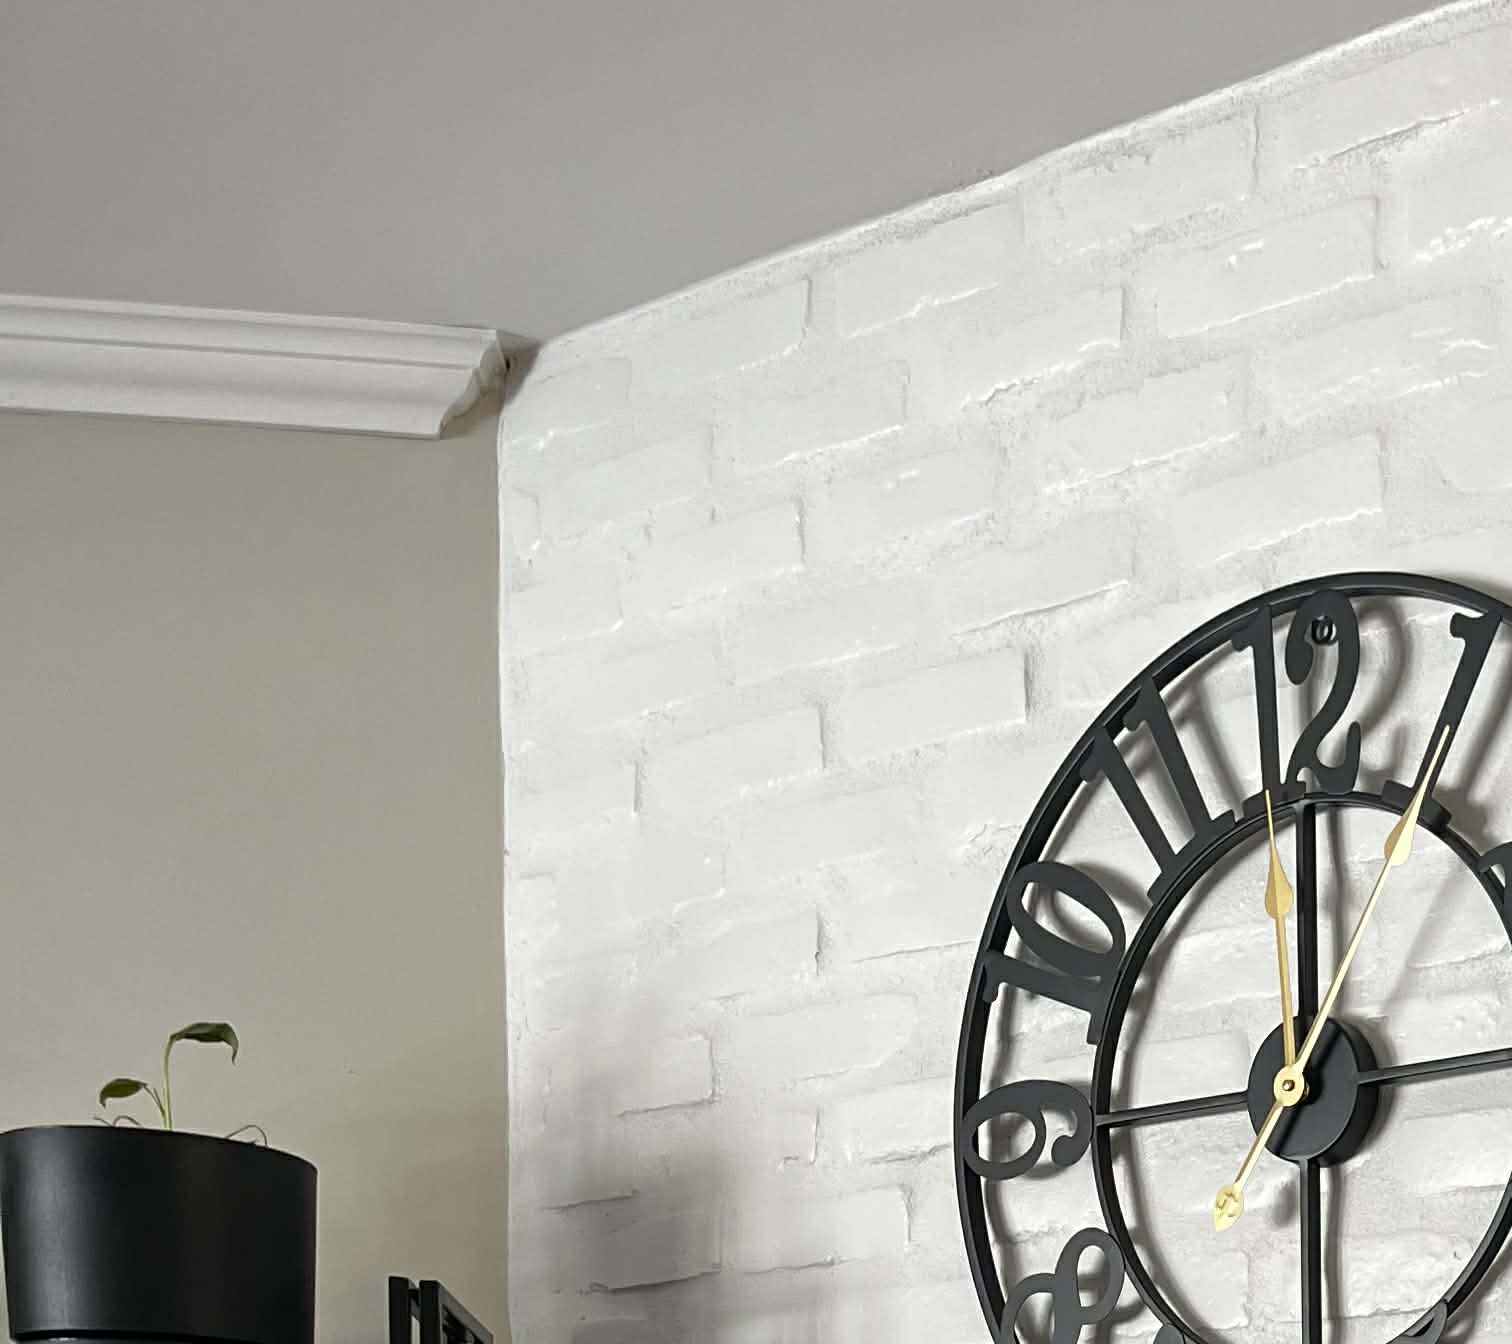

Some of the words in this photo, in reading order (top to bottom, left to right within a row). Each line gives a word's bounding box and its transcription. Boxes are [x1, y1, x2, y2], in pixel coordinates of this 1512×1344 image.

[1080, 677, 1241, 902] 11
[1231, 589, 1360, 816] 12
[1382, 609, 1502, 829] 1
[984, 862, 1126, 1045] 10
[962, 1079, 1094, 1179] 9
